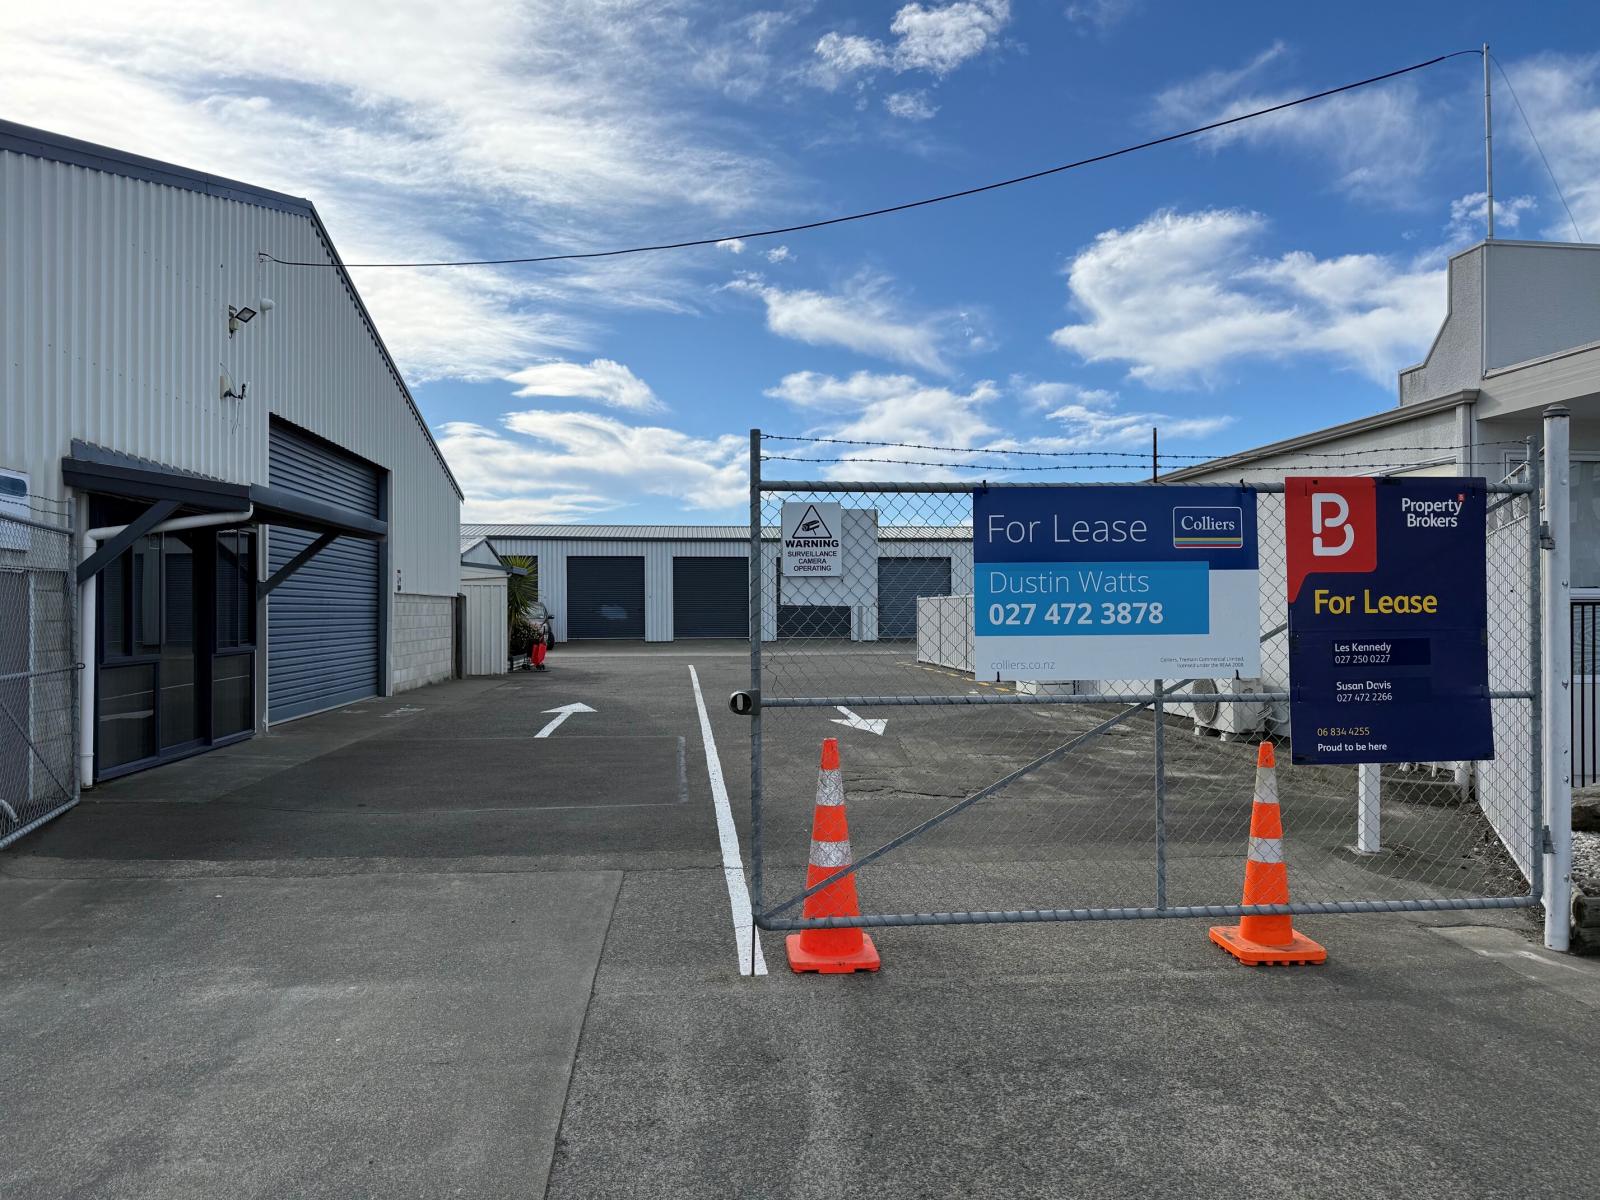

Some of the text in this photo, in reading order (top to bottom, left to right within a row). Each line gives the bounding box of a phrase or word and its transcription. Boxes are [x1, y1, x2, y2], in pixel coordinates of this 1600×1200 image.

[1402, 498, 1462, 515] Property
[1181, 516, 1236, 531] Colliers
[1406, 513, 1458, 528] Brokers
[988, 514, 1148, 544] For Lease
[785, 540, 839, 548] WARNING
[990, 571, 1150, 594] Dustin Watts
[1314, 589, 1438, 615] For Lease
[988, 602, 1164, 626] 027 472 3878
[1334, 642, 1391, 653] Les Kennedy
[1334, 654, 1390, 664] 027 250 0227
[990, 660, 1056, 671] colliers.co.nz
[1336, 680, 1392, 690] Susan Davis
[1336, 692, 1393, 702] 027 472 2266
[1317, 727, 1370, 737] 06 834 4255
[1317, 742, 1388, 752] Proud to be here
